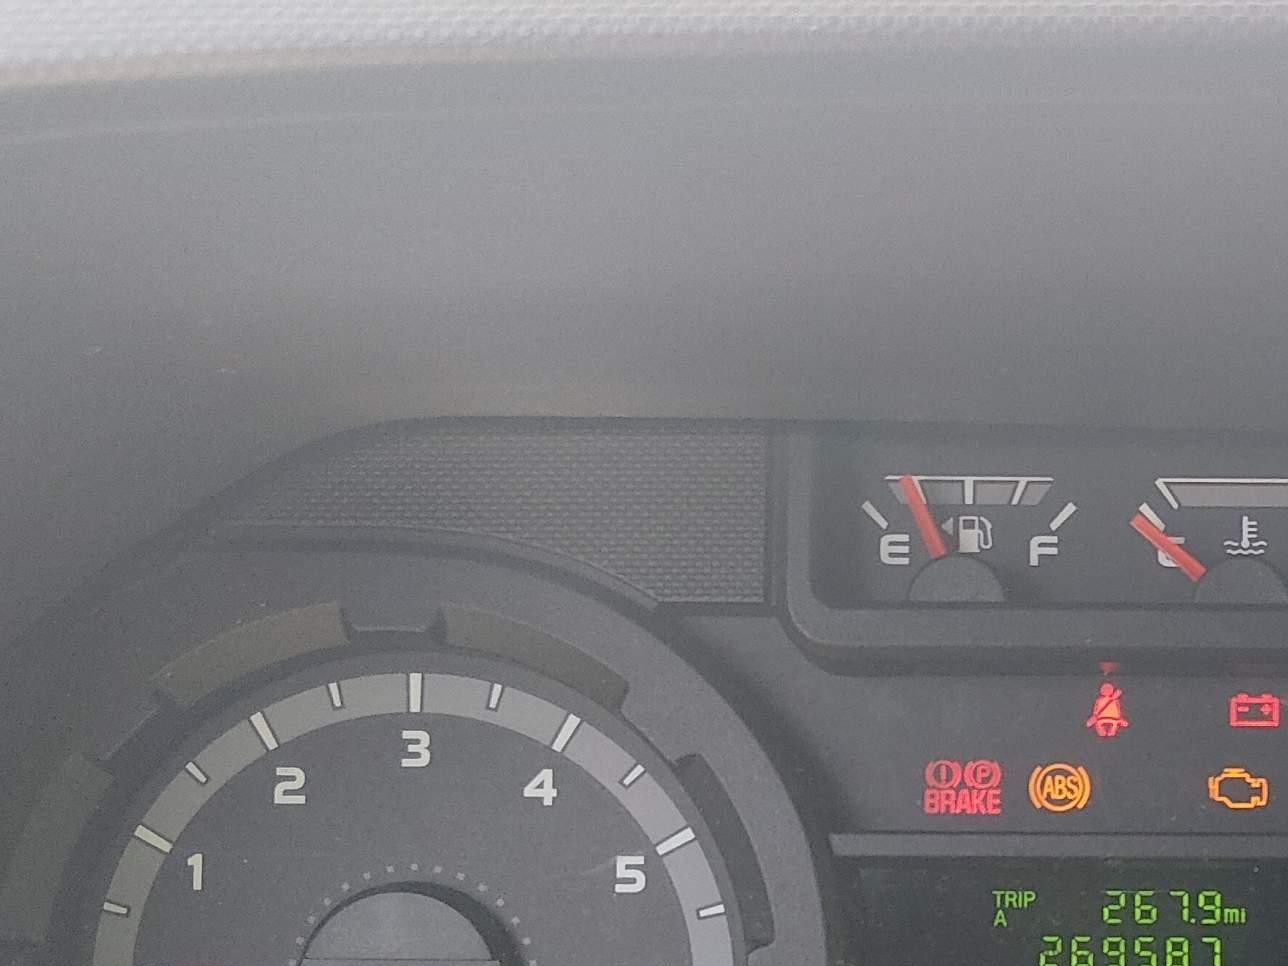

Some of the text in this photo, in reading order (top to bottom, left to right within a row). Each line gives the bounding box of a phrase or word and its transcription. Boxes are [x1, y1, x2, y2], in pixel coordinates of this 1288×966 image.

[879, 534, 910, 566] E
[1029, 535, 1059, 567] F
[401, 730, 431, 767] 3
[273, 767, 306, 805] 2
[523, 769, 558, 806] 4
[924, 789, 1001, 815] BRAKE
[1042, 776, 1079, 801] ABS
[187, 853, 203, 890] 1
[614, 856, 647, 893] 5
[992, 891, 1037, 909] TRIP
[1223, 906, 1247, 925] mi
[993, 910, 1008, 928] A
